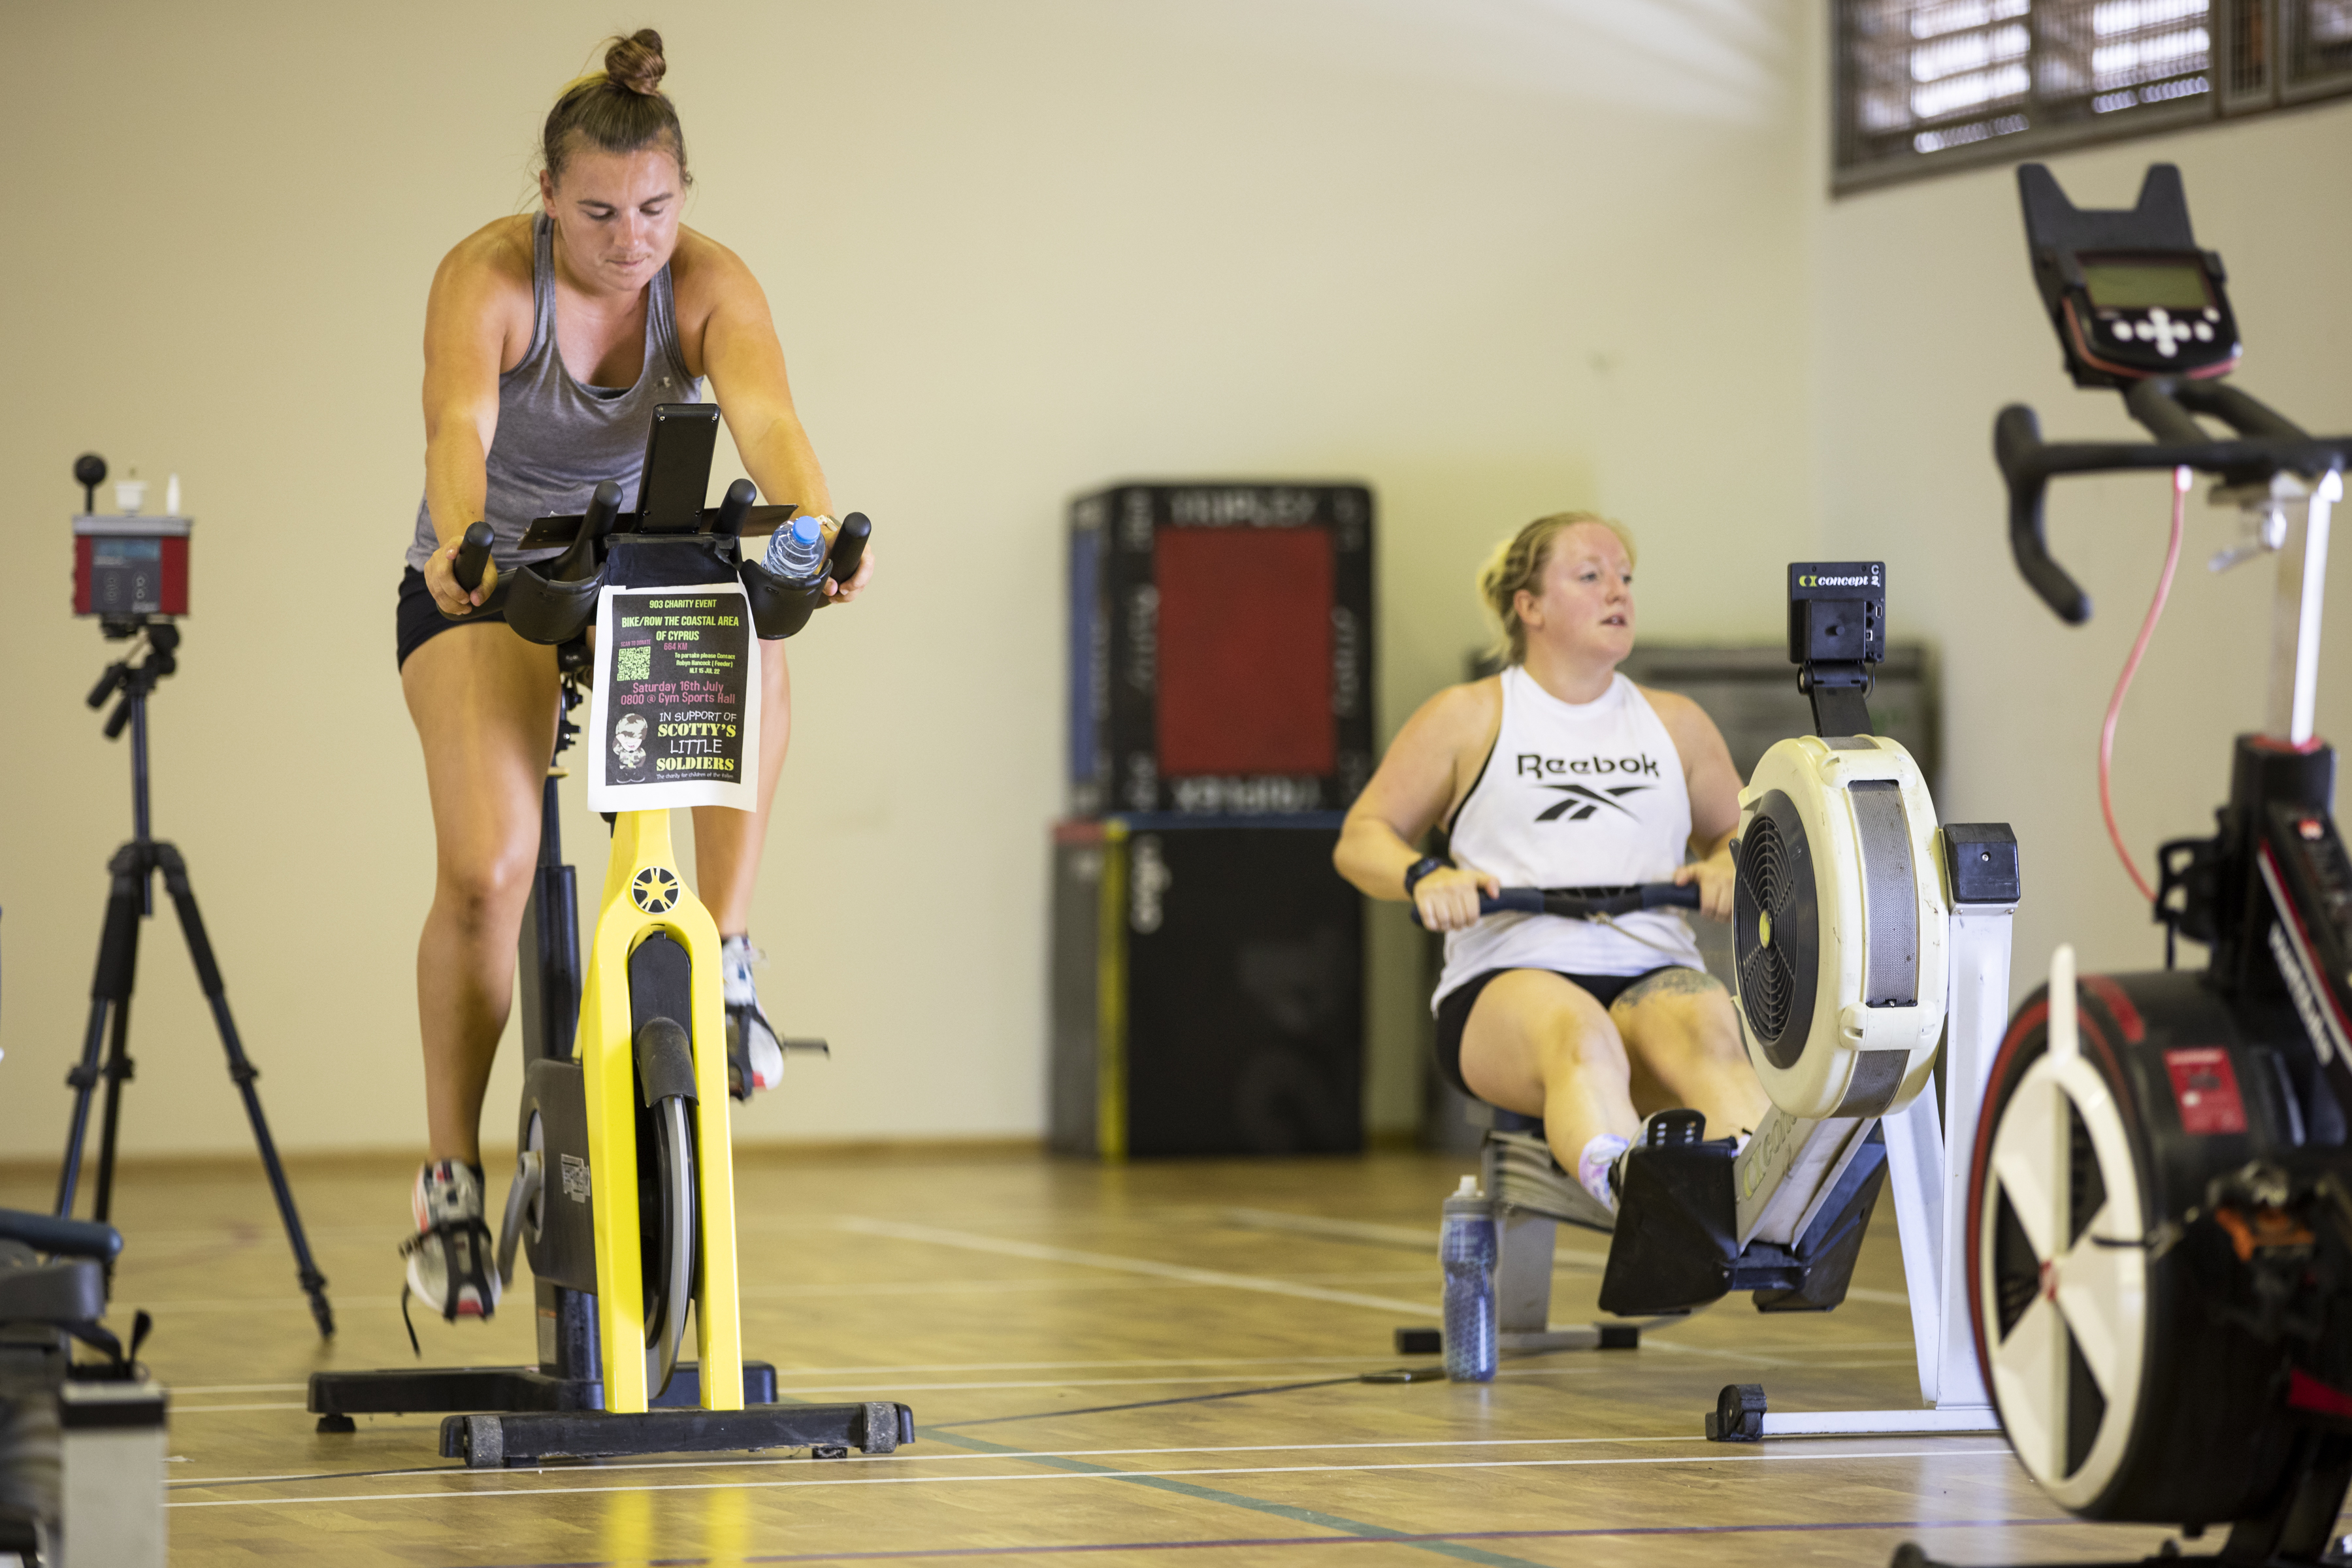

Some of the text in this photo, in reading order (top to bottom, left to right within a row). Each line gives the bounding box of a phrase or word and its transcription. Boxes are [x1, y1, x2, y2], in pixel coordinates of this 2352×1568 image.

[1818, 576, 1869, 587] concept
[649, 599, 717, 608] 903 CHARITY EVENT
[622, 616, 739, 628] BIKE/ROW THE COASTAL AREA
[656, 630, 699, 641] OF CYPRUS
[664, 642, 688, 650] 664 KM
[633, 681, 724, 694] Saturday 16th July
[621, 692, 735, 706] 0800 @ Gym Sports Hall
[659, 710, 737, 722] IN SUPPORT OF
[670, 739, 722, 755] LITTLE
[656, 757, 734, 771] SOLDIERS
[1517, 753, 1660, 779] Reebok
